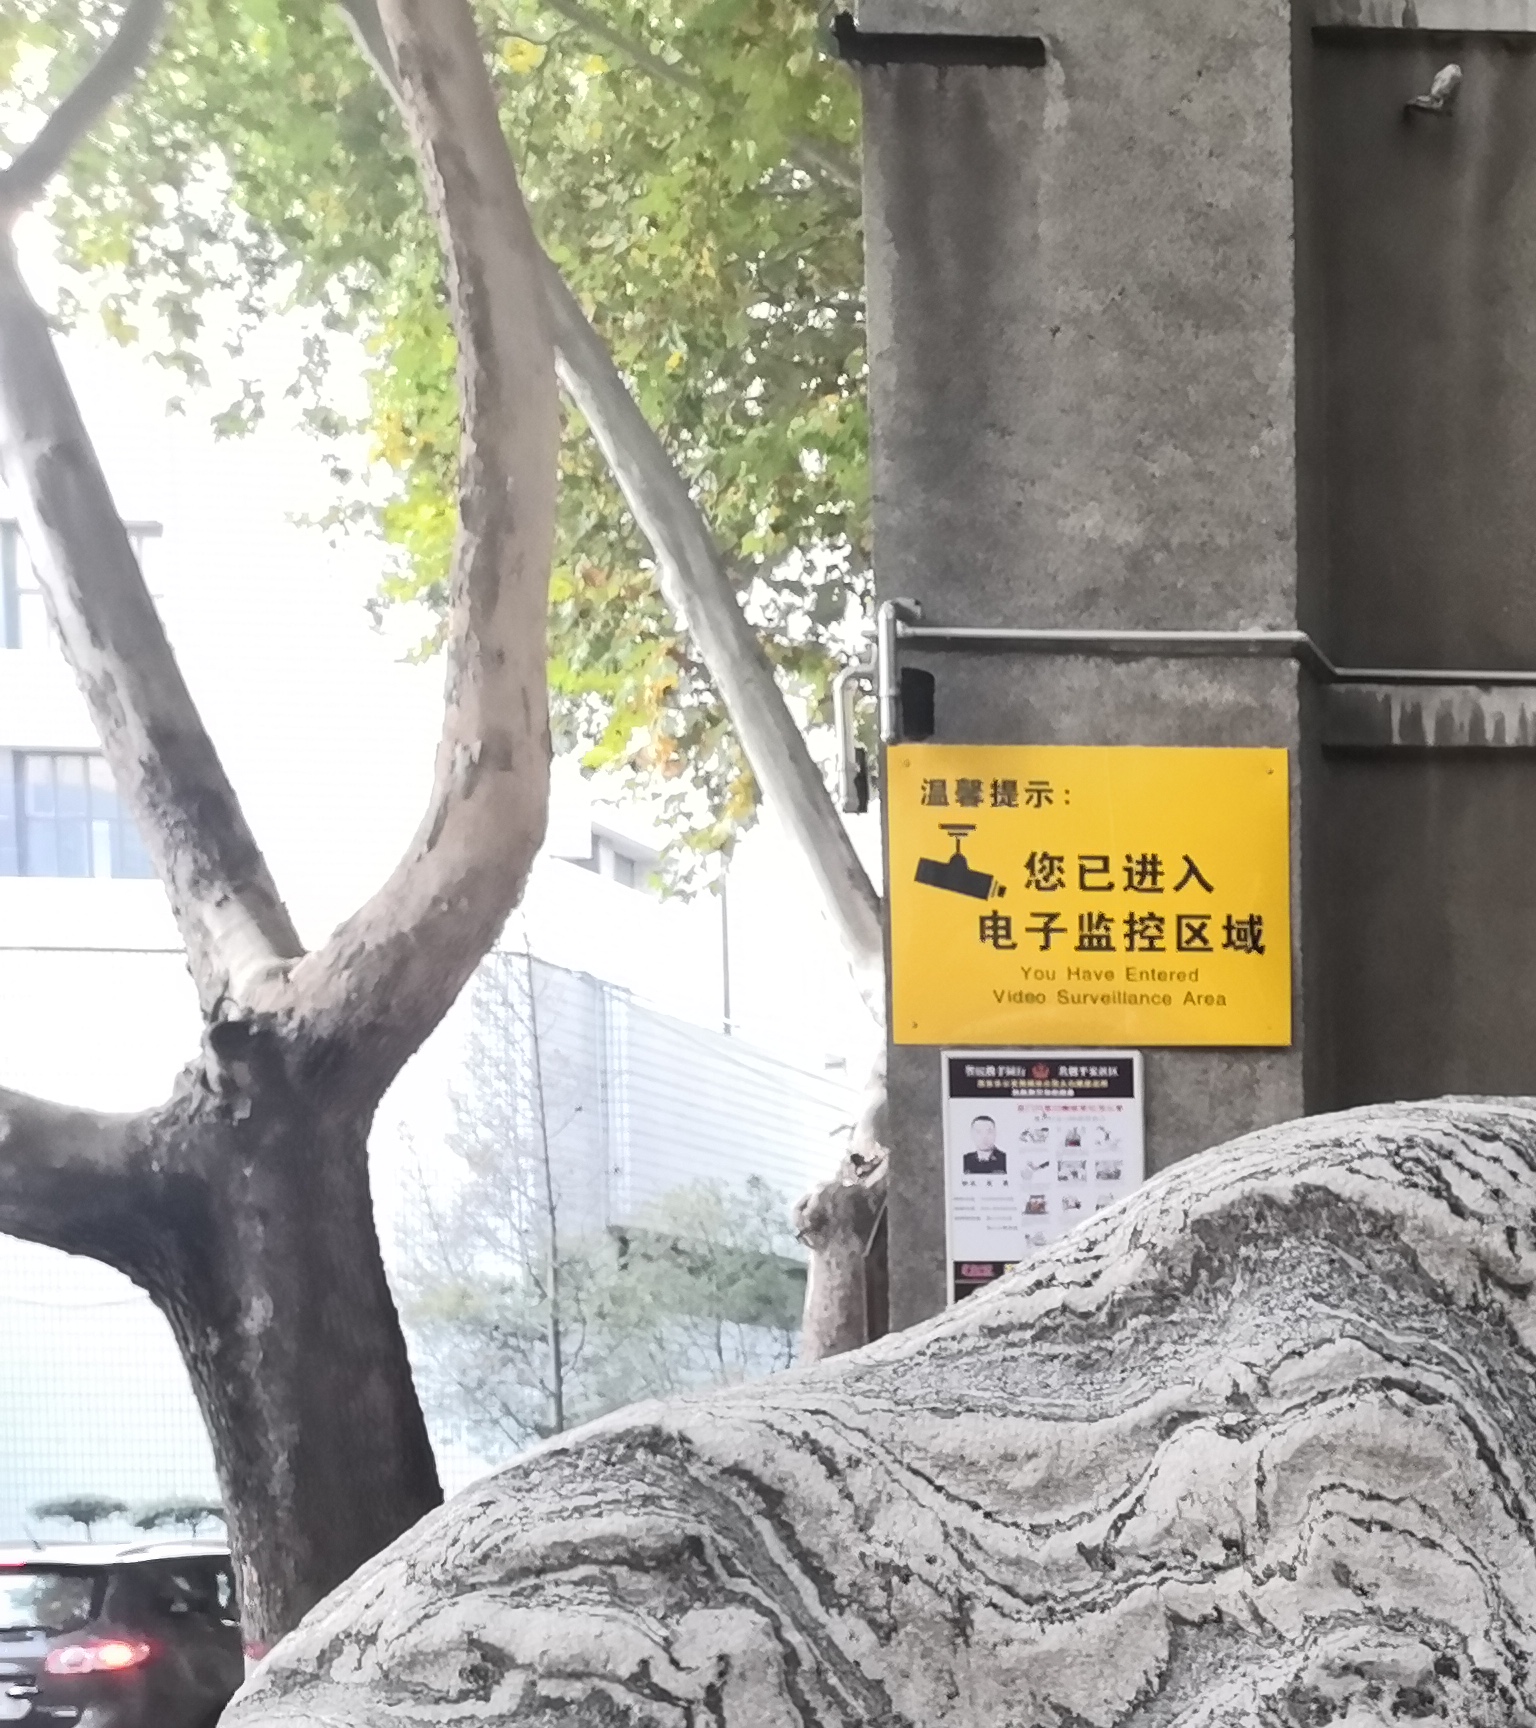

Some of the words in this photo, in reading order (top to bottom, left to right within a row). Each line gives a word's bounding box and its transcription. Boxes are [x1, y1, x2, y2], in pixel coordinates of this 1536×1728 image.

[1024, 850, 1214, 893] 您已进入
[979, 909, 1266, 955] 电子监控区域
[1020, 965, 1056, 981] You
[1067, 966, 1115, 982] Have
[1125, 966, 1199, 983] Entered
[993, 988, 1046, 1005] Video
[1057, 989, 1172, 1006] Surveillance
[1183, 991, 1227, 1006] Area
